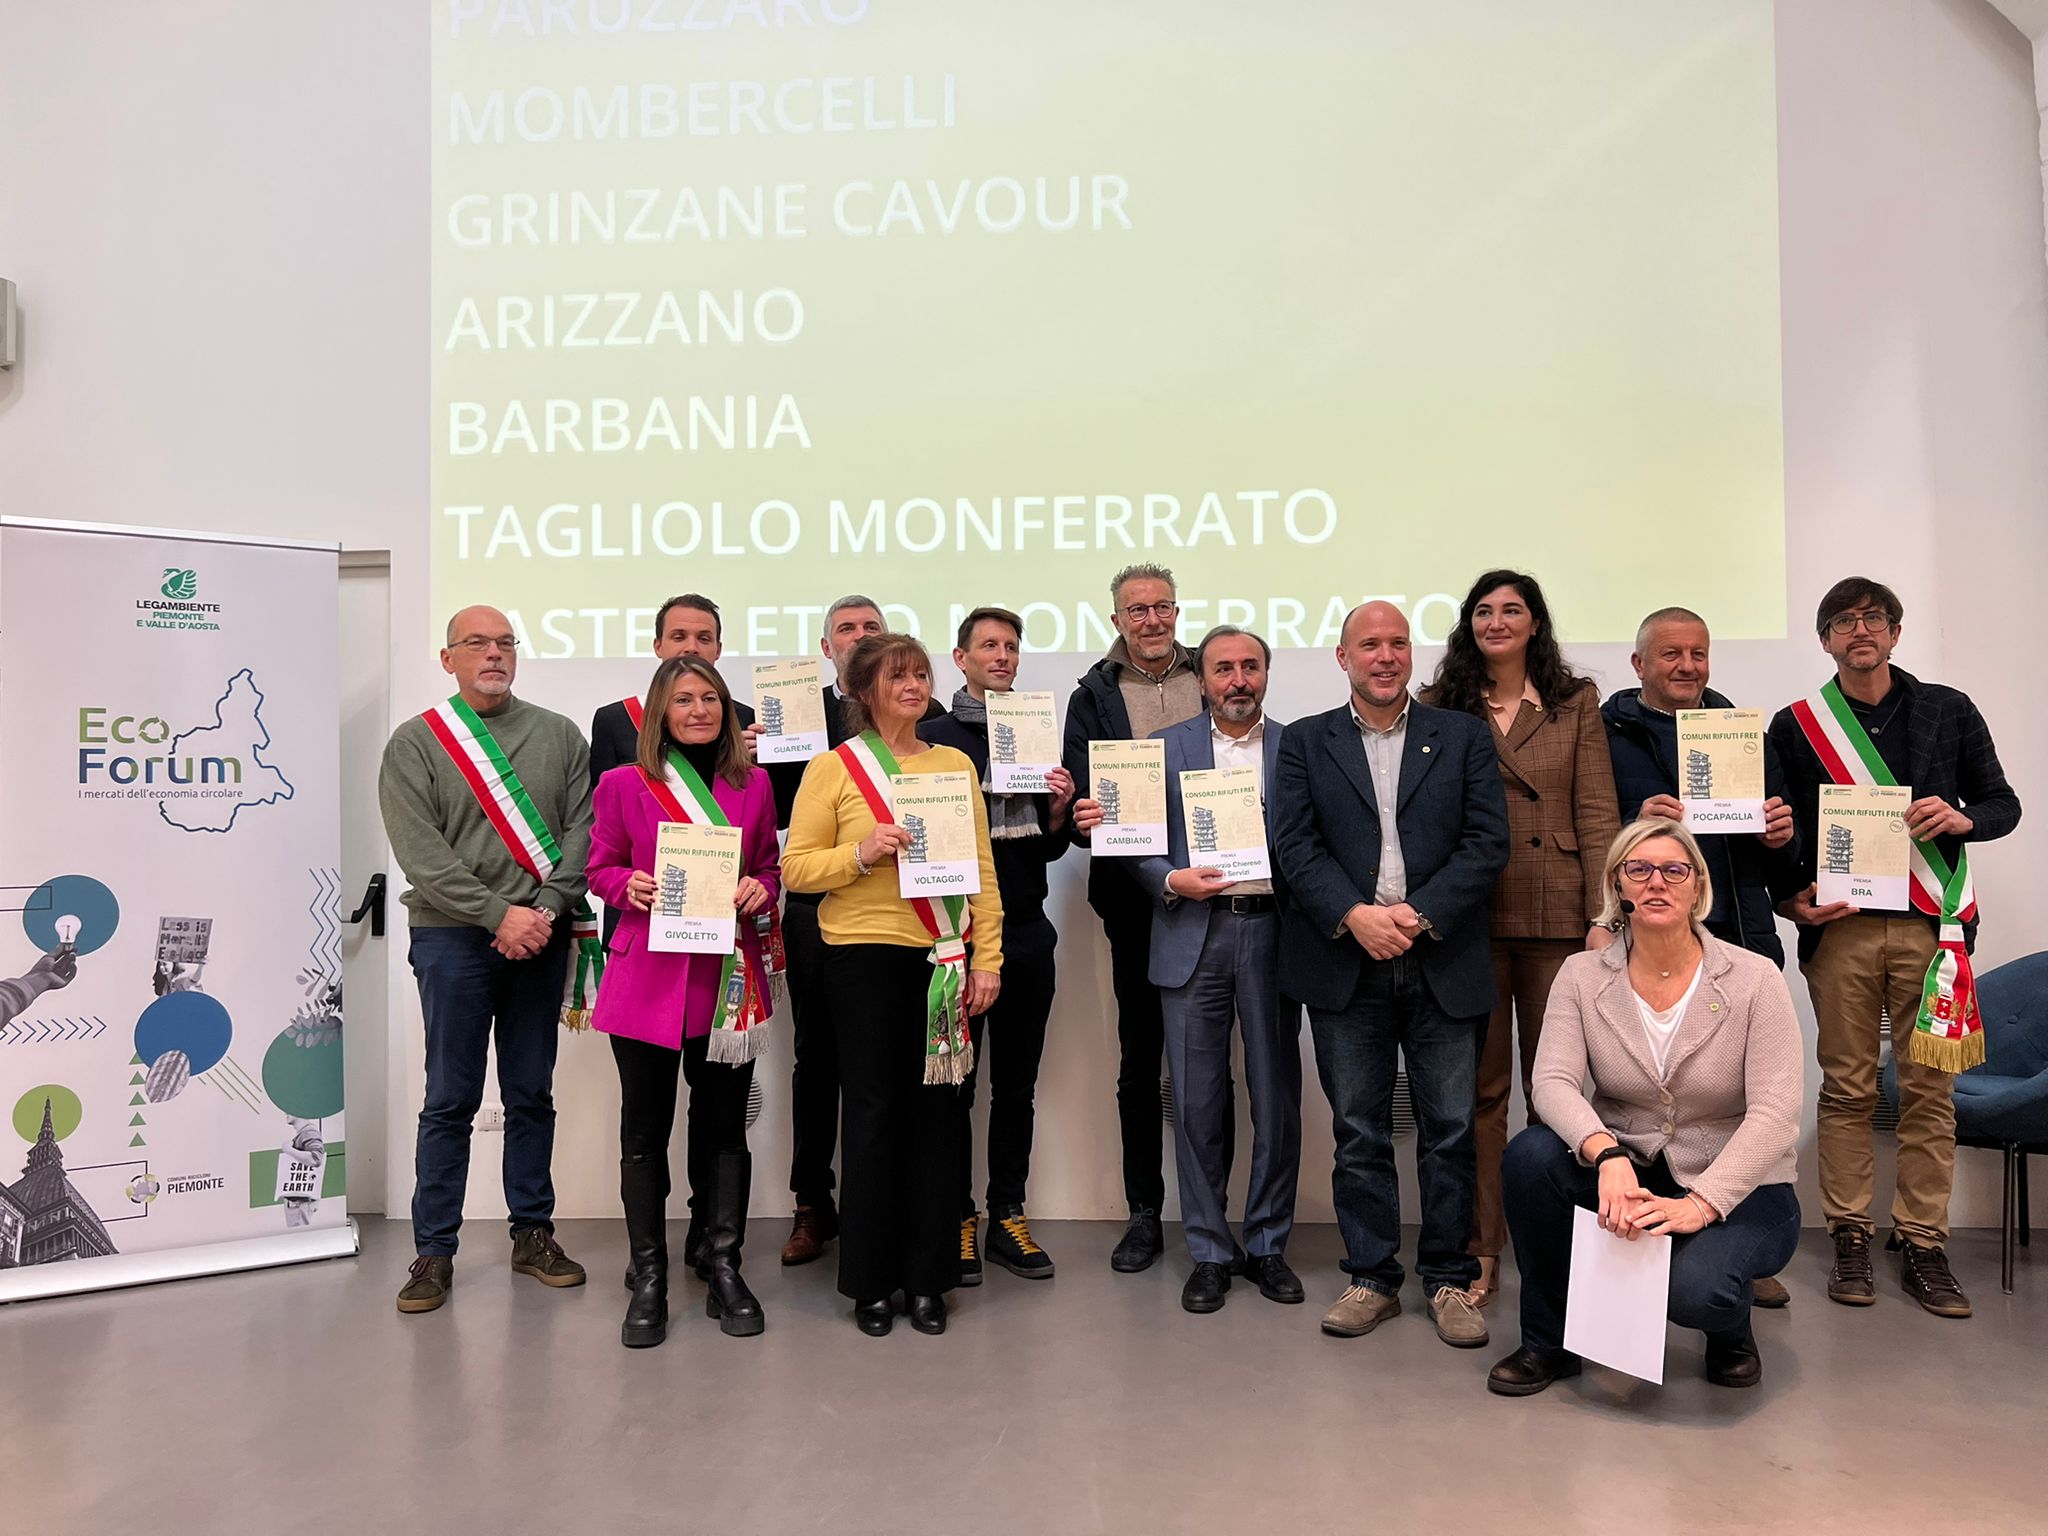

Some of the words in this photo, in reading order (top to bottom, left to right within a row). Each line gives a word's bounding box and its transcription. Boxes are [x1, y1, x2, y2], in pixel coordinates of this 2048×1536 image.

[448, 74, 957, 145] MOMBERCELLI
[447, 183, 807, 249] GRINZANE
[833, 174, 1132, 237] CAVOUR
[445, 288, 805, 351] ARIZZANO
[449, 394, 812, 455] BARBANIA
[444, 500, 801, 559] TAGLIOLO
[829, 488, 1338, 552] MONFERRATO
[136, 600, 221, 612] LEGAMBIENTE
[153, 611, 205, 621] PIEMONTE
[145, 620, 176, 629] VALLE
[178, 621, 221, 631] D'AOSTA
[79, 707, 170, 744] Eco
[1681, 733, 1711, 741] COMUNI
[1712, 732, 1739, 740] RIFIUTI
[774, 744, 812, 754] GUARENE
[79, 748, 242, 785] Forum
[84, 789, 124, 798] mercati
[127, 789, 198, 798] dell'economia
[201, 789, 243, 798] circolare
[896, 797, 925, 805] COMUNI
[1693, 813, 1753, 821] POCAPAGLIA
[1823, 808, 1855, 816] COMUNI
[1856, 809, 1885, 817] RIFIUTI
[1886, 810, 1905, 818] FREE
[1106, 837, 1152, 845] CAMBIANO
[660, 846, 690, 855] COMUNI
[691, 849, 717, 857] RIFIUTI
[717, 850, 736, 859] FREE
[914, 874, 964, 885] VOLTAGGIO
[1851, 888, 1873, 896] BRA
[665, 931, 718, 941] GIVOLETTO
[290, 1172, 309, 1181] THE
[167, 1177, 225, 1194] PIEMONTE
[282, 1182, 315, 1192] EARTH
